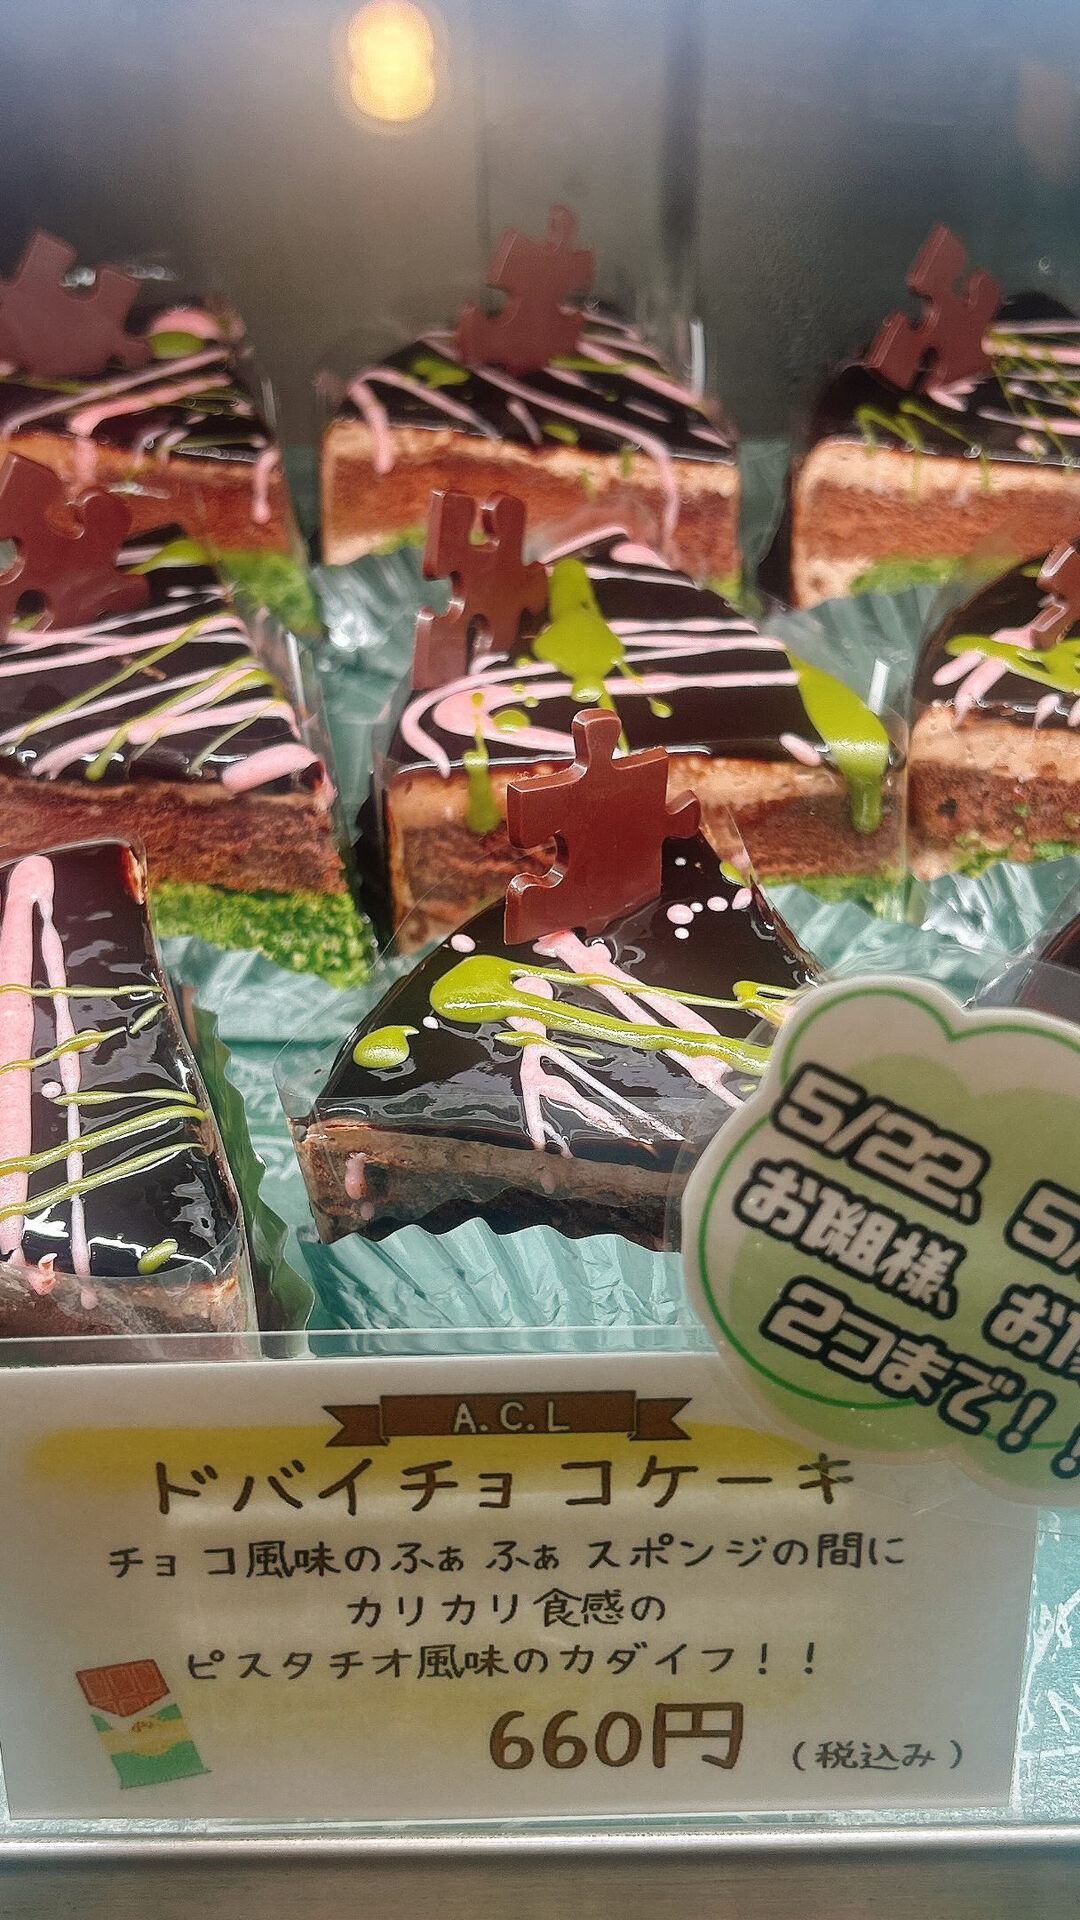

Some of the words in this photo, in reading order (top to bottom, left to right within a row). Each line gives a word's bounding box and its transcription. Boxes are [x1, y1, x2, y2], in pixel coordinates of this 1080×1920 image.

[453, 1401, 571, 1434] A.C.L
[154, 1453, 855, 1516] ドバイチョコケーキ
[346, 1588, 666, 1628] カリカリ食感の
[488, 1702, 744, 1771] 660円
[792, 1739, 964, 1771] （税込み）
